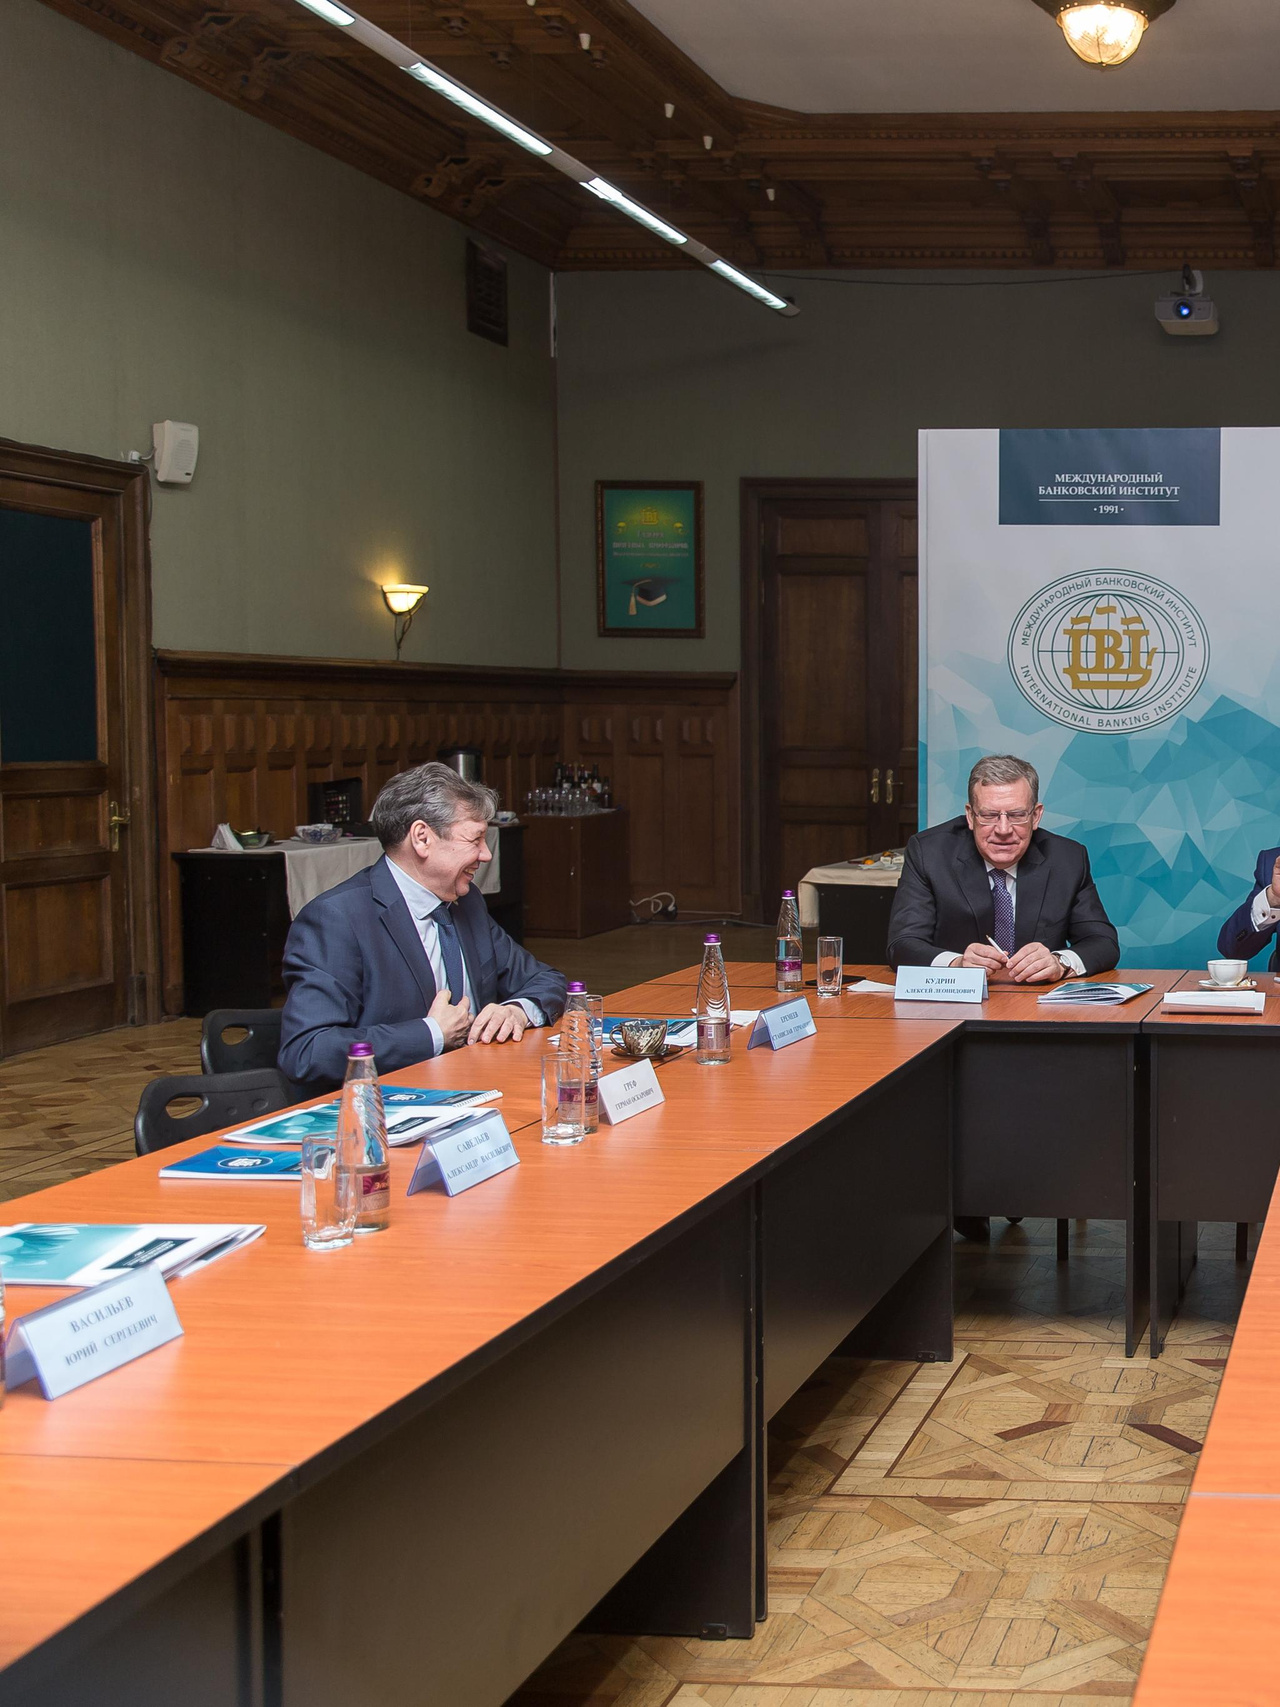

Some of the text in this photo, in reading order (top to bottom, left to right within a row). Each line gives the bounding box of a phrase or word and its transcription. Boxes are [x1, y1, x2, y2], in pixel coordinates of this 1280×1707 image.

[1038, 485, 1180, 497] БАНКОВСКИЙ ИНСТИТУТ
[1055, 472, 1163, 484] МЕЖДУНАРОДНЫЙ
[1021, 577, 1197, 647] МЕЖДУНАРОДНЫЙ БАНКОВСКИЙ ИНСТИТУТ
[1020, 665, 1197, 728] INTERNATIONAL BANKING INSTITUTE
[623, 1080, 638, 1092] ГРЕФ
[446, 1142, 513, 1180] АЛЕКСАНДР ВАСИЛЬЕВИЧ
[457, 1132, 490, 1153] САВЕЛЬЕВ
[70, 1296, 135, 1333] ВАСИЛЬЕВ
[65, 1314, 158, 1366] ЮРИЙ СЕРГЕЕВИЧ
